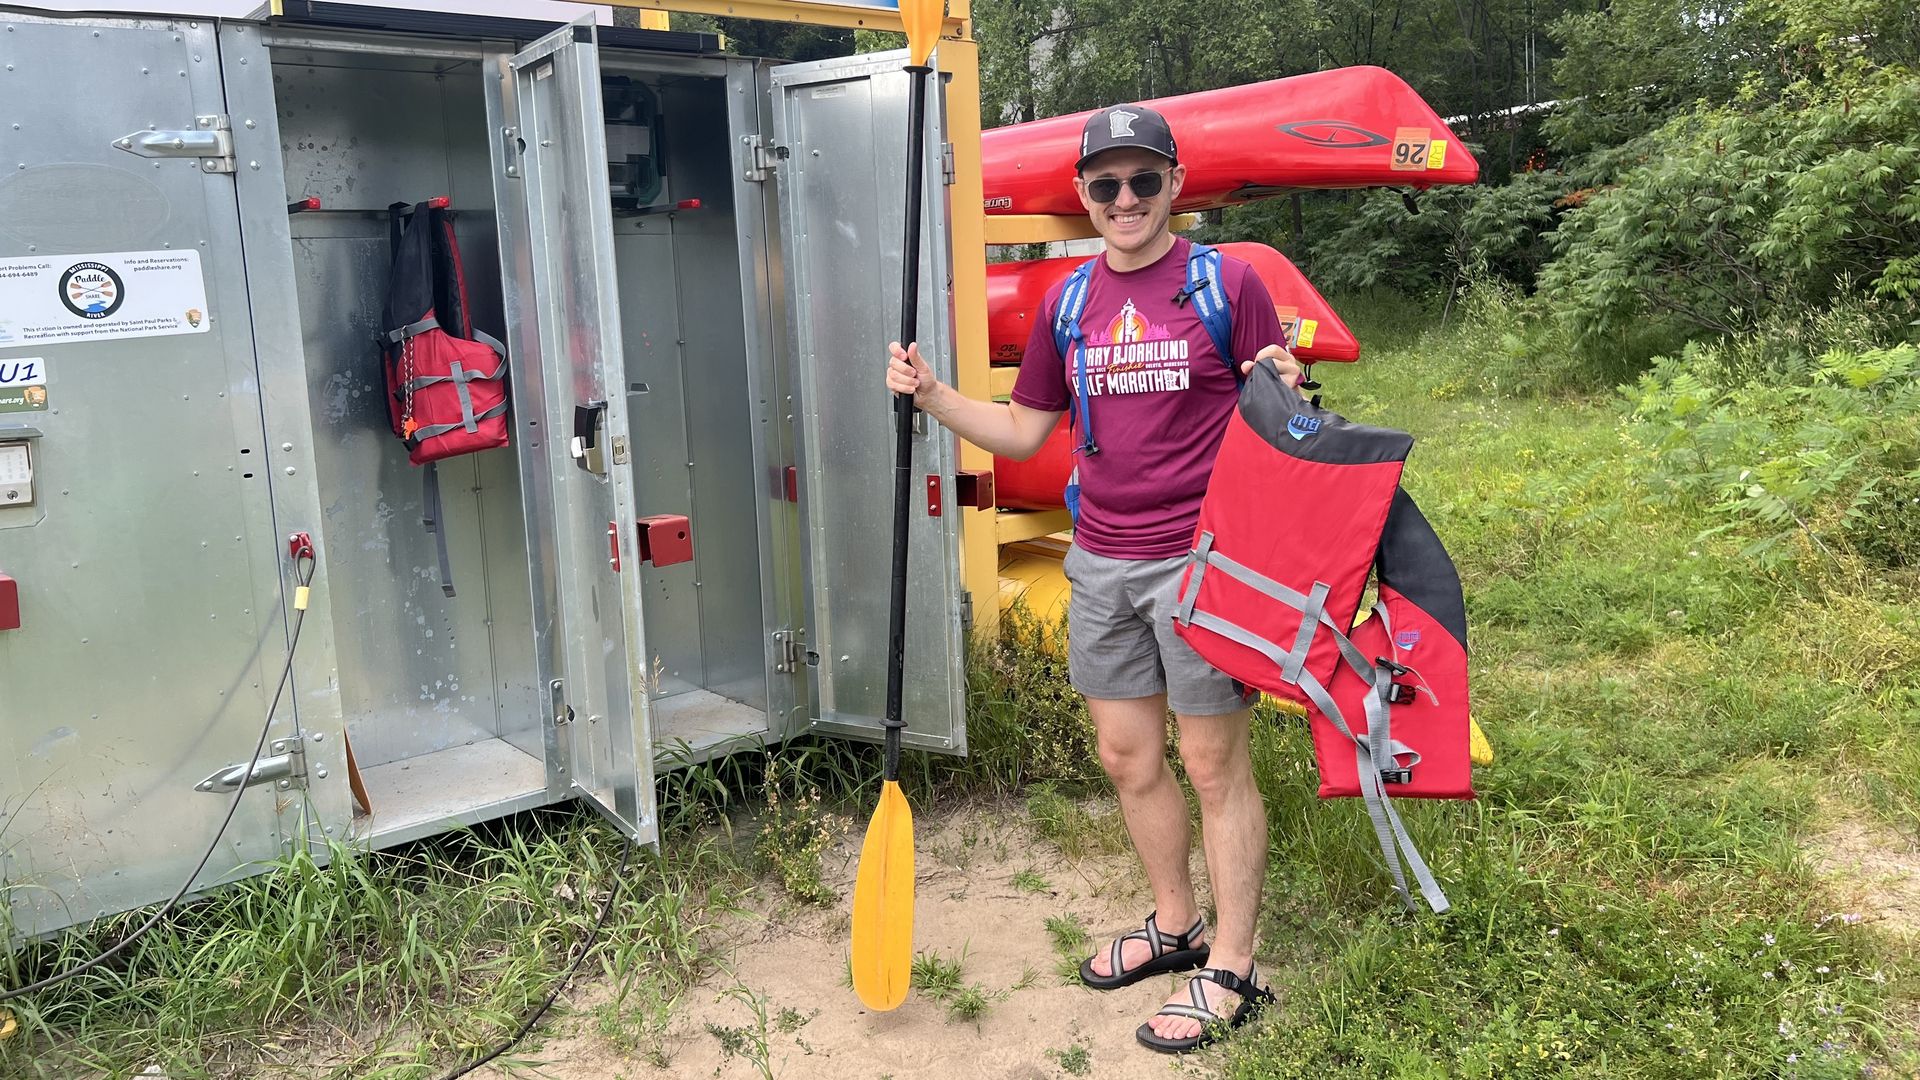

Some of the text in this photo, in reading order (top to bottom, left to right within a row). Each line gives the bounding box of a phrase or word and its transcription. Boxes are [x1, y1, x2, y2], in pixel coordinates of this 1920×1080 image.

[1394, 142, 1426, 164] 26
[69, 262, 109, 274] MISSISSIPPI
[75, 274, 105, 283] Paddle
[86, 311, 106, 319] RIVER
[1073, 339, 1188, 368] GRRY BJORKLUND
[1106, 368, 1190, 395] MARATHN
